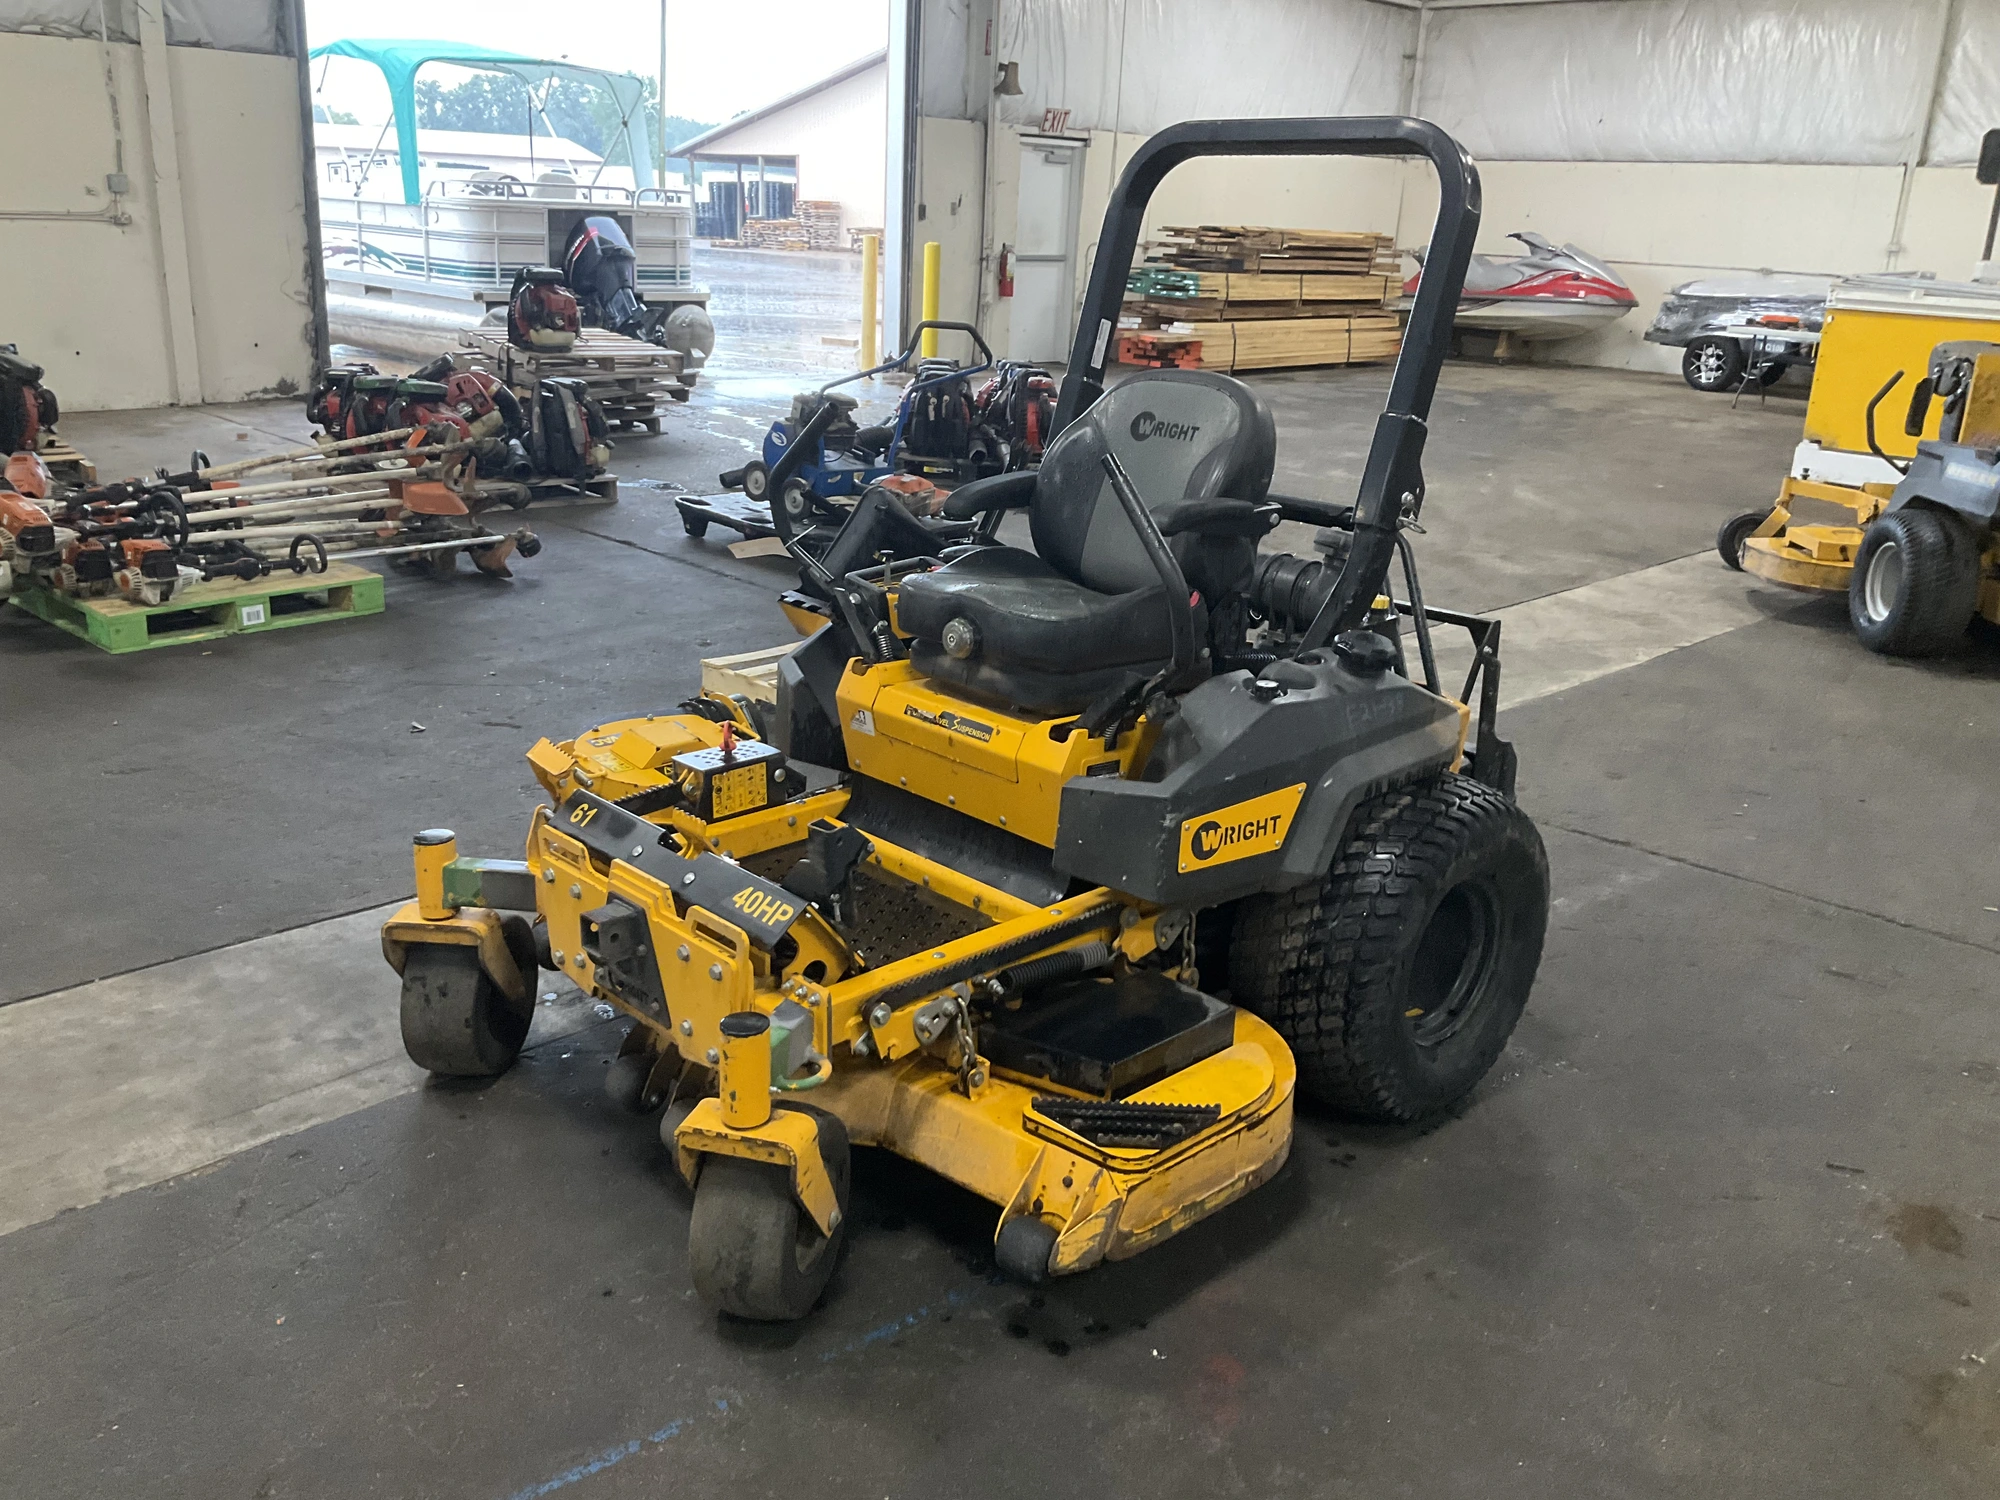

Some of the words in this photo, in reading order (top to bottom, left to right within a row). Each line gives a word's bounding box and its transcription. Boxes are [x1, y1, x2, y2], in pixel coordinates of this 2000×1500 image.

[1041, 110, 1070, 133] EXIT
[1134, 414, 1200, 441] WRIGHT
[951, 718, 990, 741] SUSPENSION
[570, 803, 598, 828] 61
[1196, 815, 1281, 856] WRIGHT
[732, 887, 794, 926] 40HP
